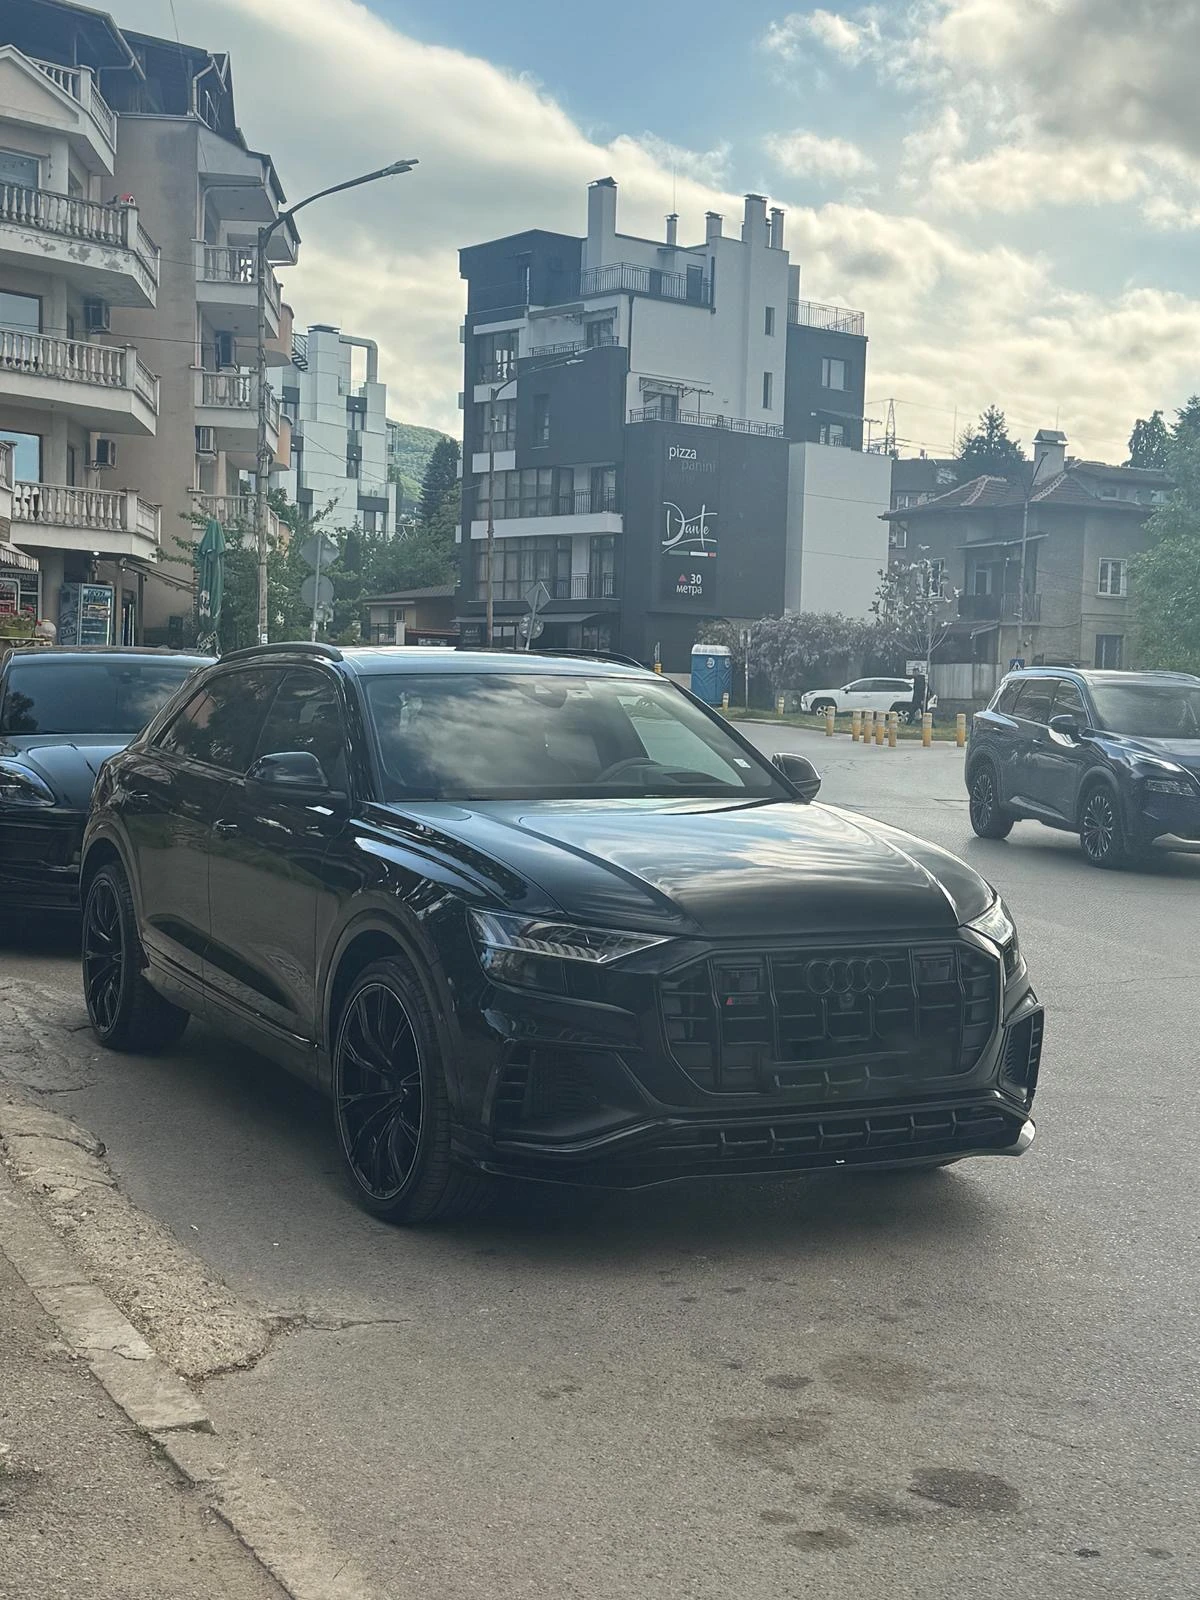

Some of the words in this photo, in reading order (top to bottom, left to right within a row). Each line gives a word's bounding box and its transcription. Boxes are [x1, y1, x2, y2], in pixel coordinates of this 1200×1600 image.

[669, 444, 697, 460] pizza
[662, 502, 717, 549] Dante
[690, 574, 702, 585] 30
[676, 584, 702, 595] метра
